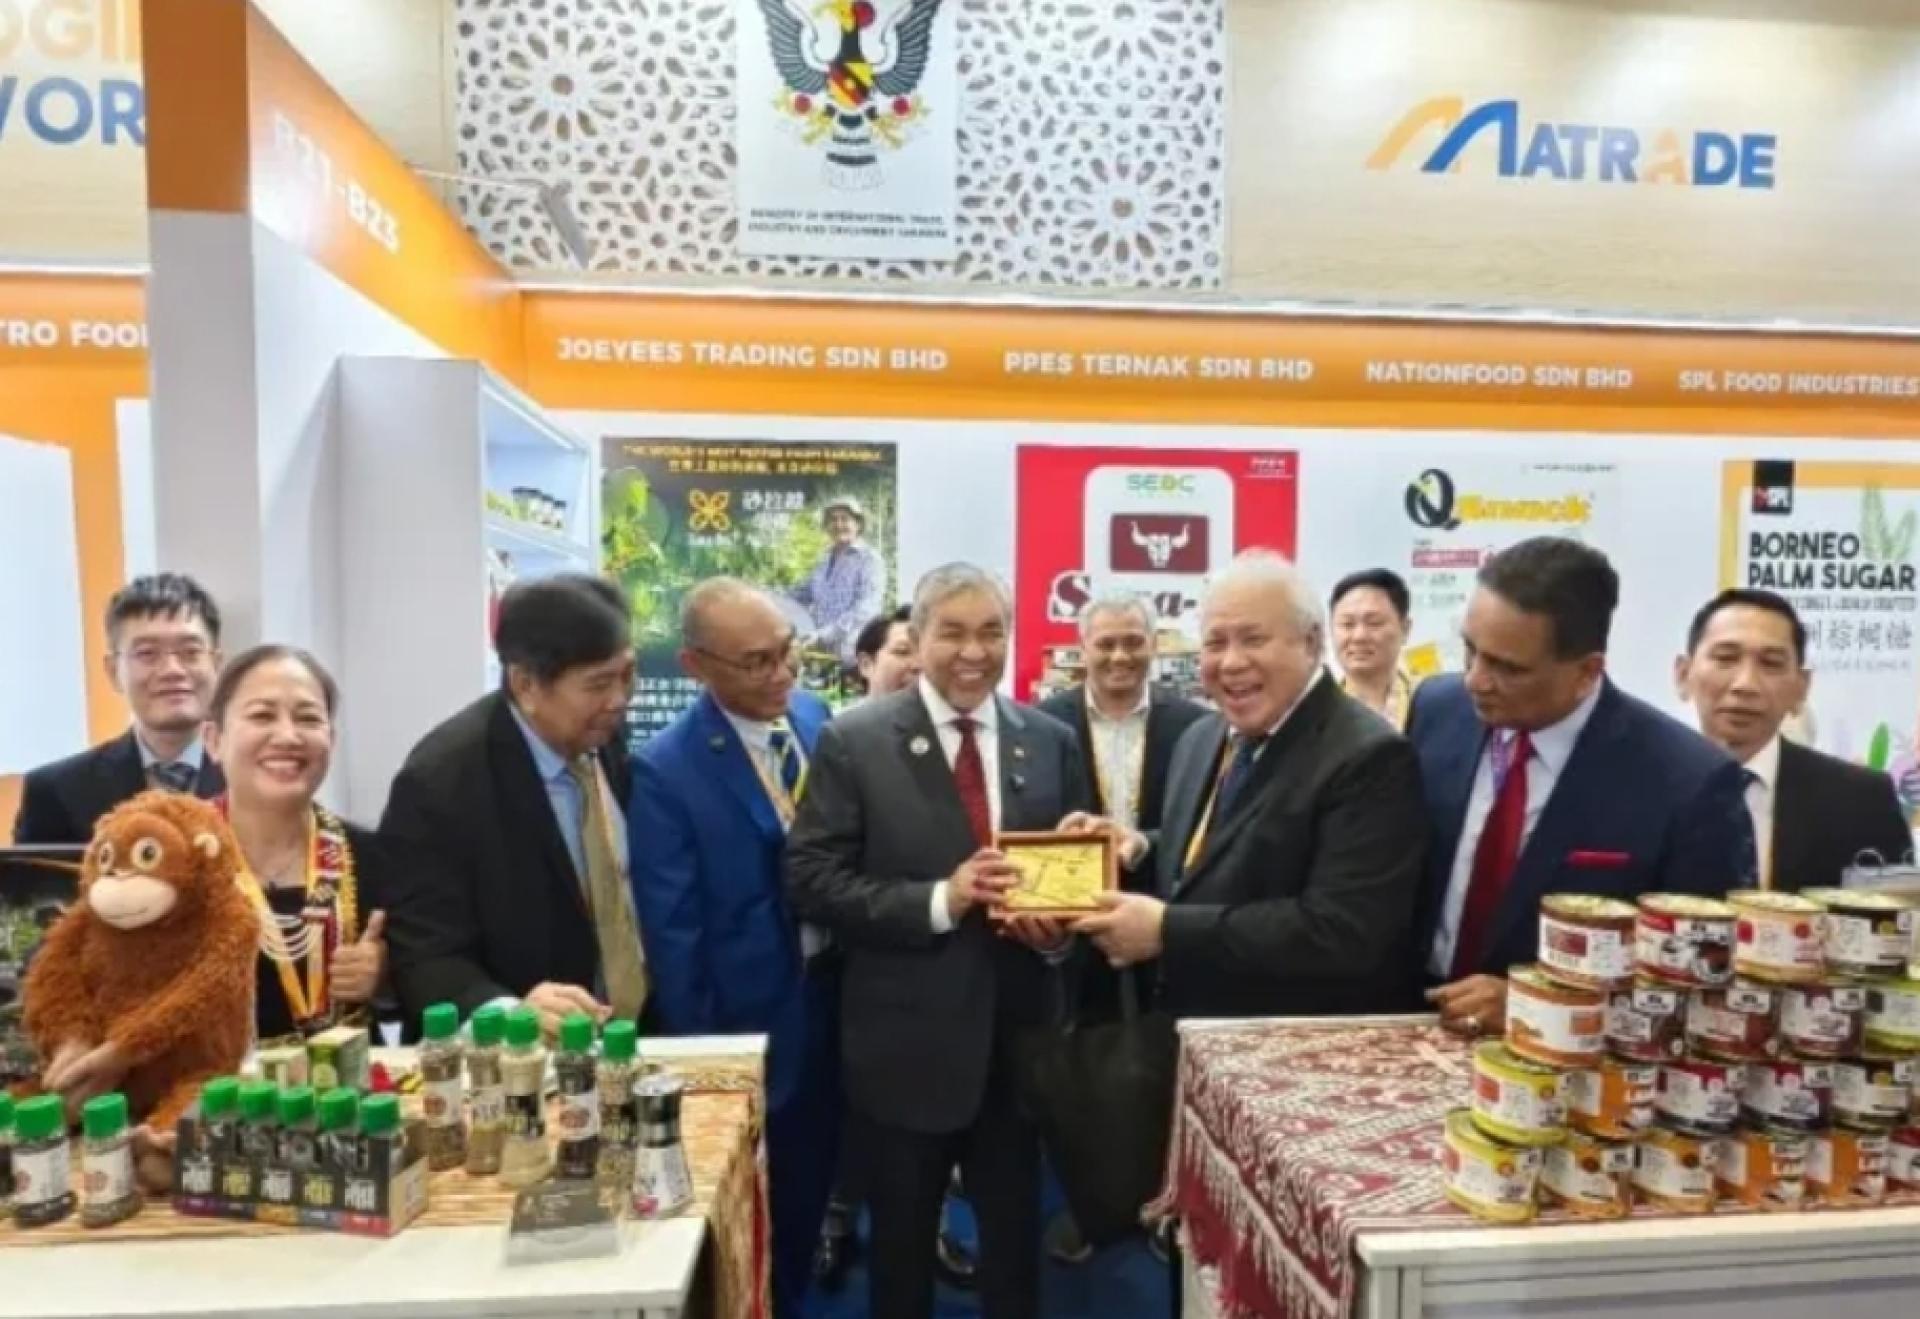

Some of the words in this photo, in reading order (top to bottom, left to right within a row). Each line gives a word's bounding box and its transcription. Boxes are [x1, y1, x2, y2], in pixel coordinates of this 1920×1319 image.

[1365, 95, 1777, 189] MATRADE
[557, 337, 683, 363] JOEYEES
[691, 341, 816, 367] TRADING
[825, 345, 880, 369] SDN
[889, 348, 948, 370] BHD
[1004, 351, 1073, 374] PPES
[1080, 353, 1190, 377] TERNAK
[1199, 356, 1251, 379] SDN
[1260, 358, 1314, 381] BHD
[1366, 361, 1526, 385] NATIONFOOD
[1532, 364, 1579, 387] SDN
[1586, 367, 1633, 389] BHD
[1679, 370, 1716, 392] SPL
[1724, 371, 1782, 393] FOOD
[1789, 373, 1920, 396] INDUSTRIES
[1750, 532, 1860, 560] BORNEO
[1749, 561, 1815, 590] PALM
[1821, 563, 1917, 592] SUGAR
